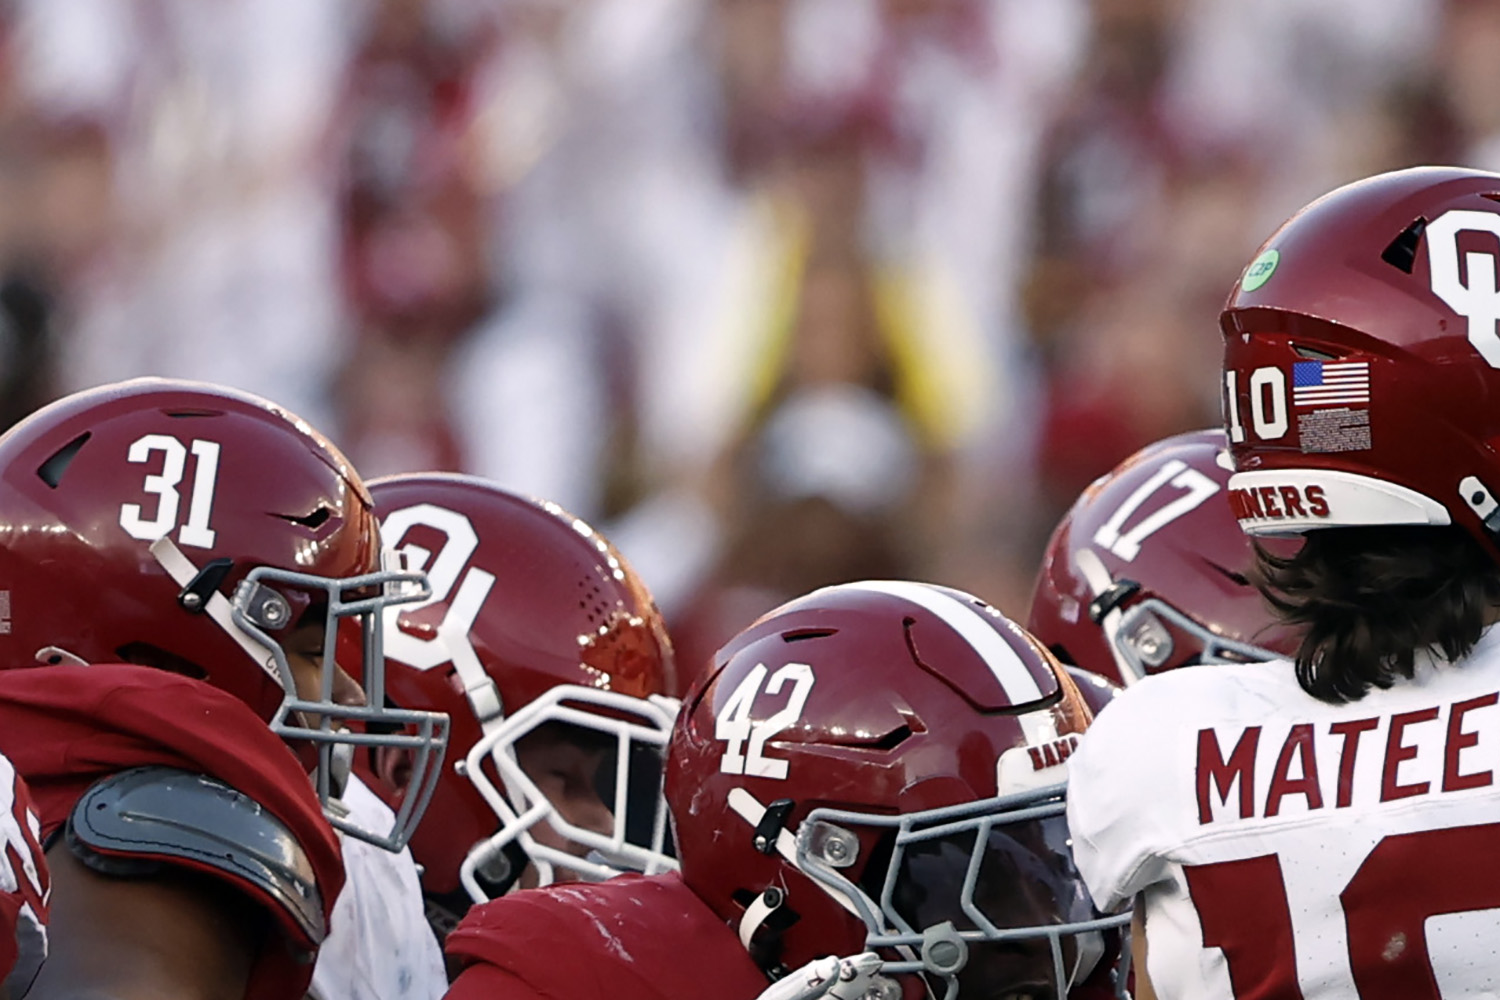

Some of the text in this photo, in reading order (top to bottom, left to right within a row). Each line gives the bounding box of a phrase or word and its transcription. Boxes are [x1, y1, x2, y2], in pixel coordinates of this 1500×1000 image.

[1227, 366, 1288, 443] 10
[119, 434, 221, 549] 31
[1093, 459, 1221, 562] 17
[715, 663, 815, 780] 42
